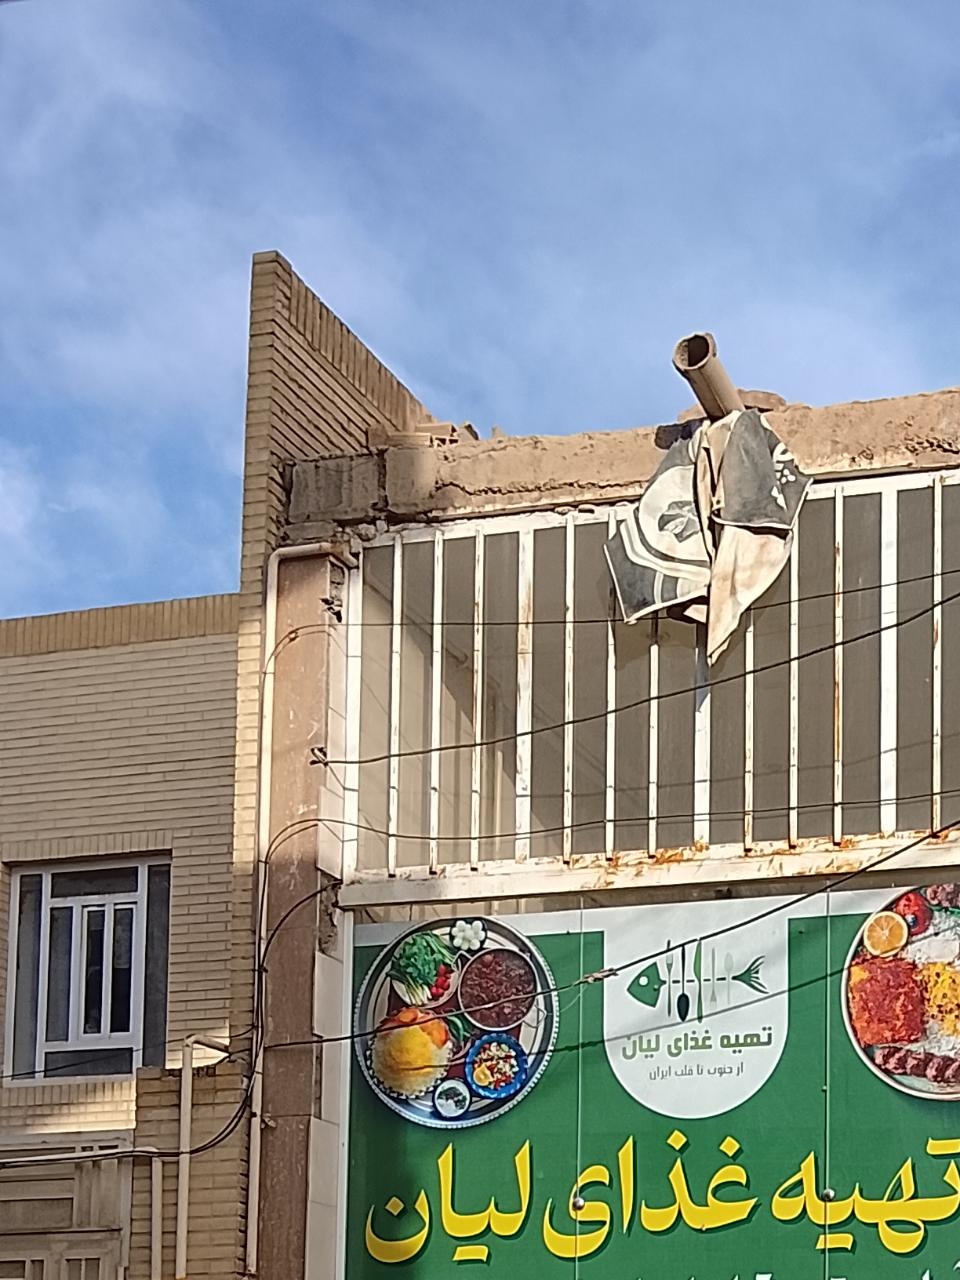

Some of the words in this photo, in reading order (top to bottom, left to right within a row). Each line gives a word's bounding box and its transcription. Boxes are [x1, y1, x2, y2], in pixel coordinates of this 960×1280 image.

[622, 1034, 661, 1060] لیان
[667, 1029, 713, 1057] غذای
[720, 1026, 773, 1054] تهیه
[365, 1139, 531, 1263] لیان
[542, 1129, 759, 1259] غذای
